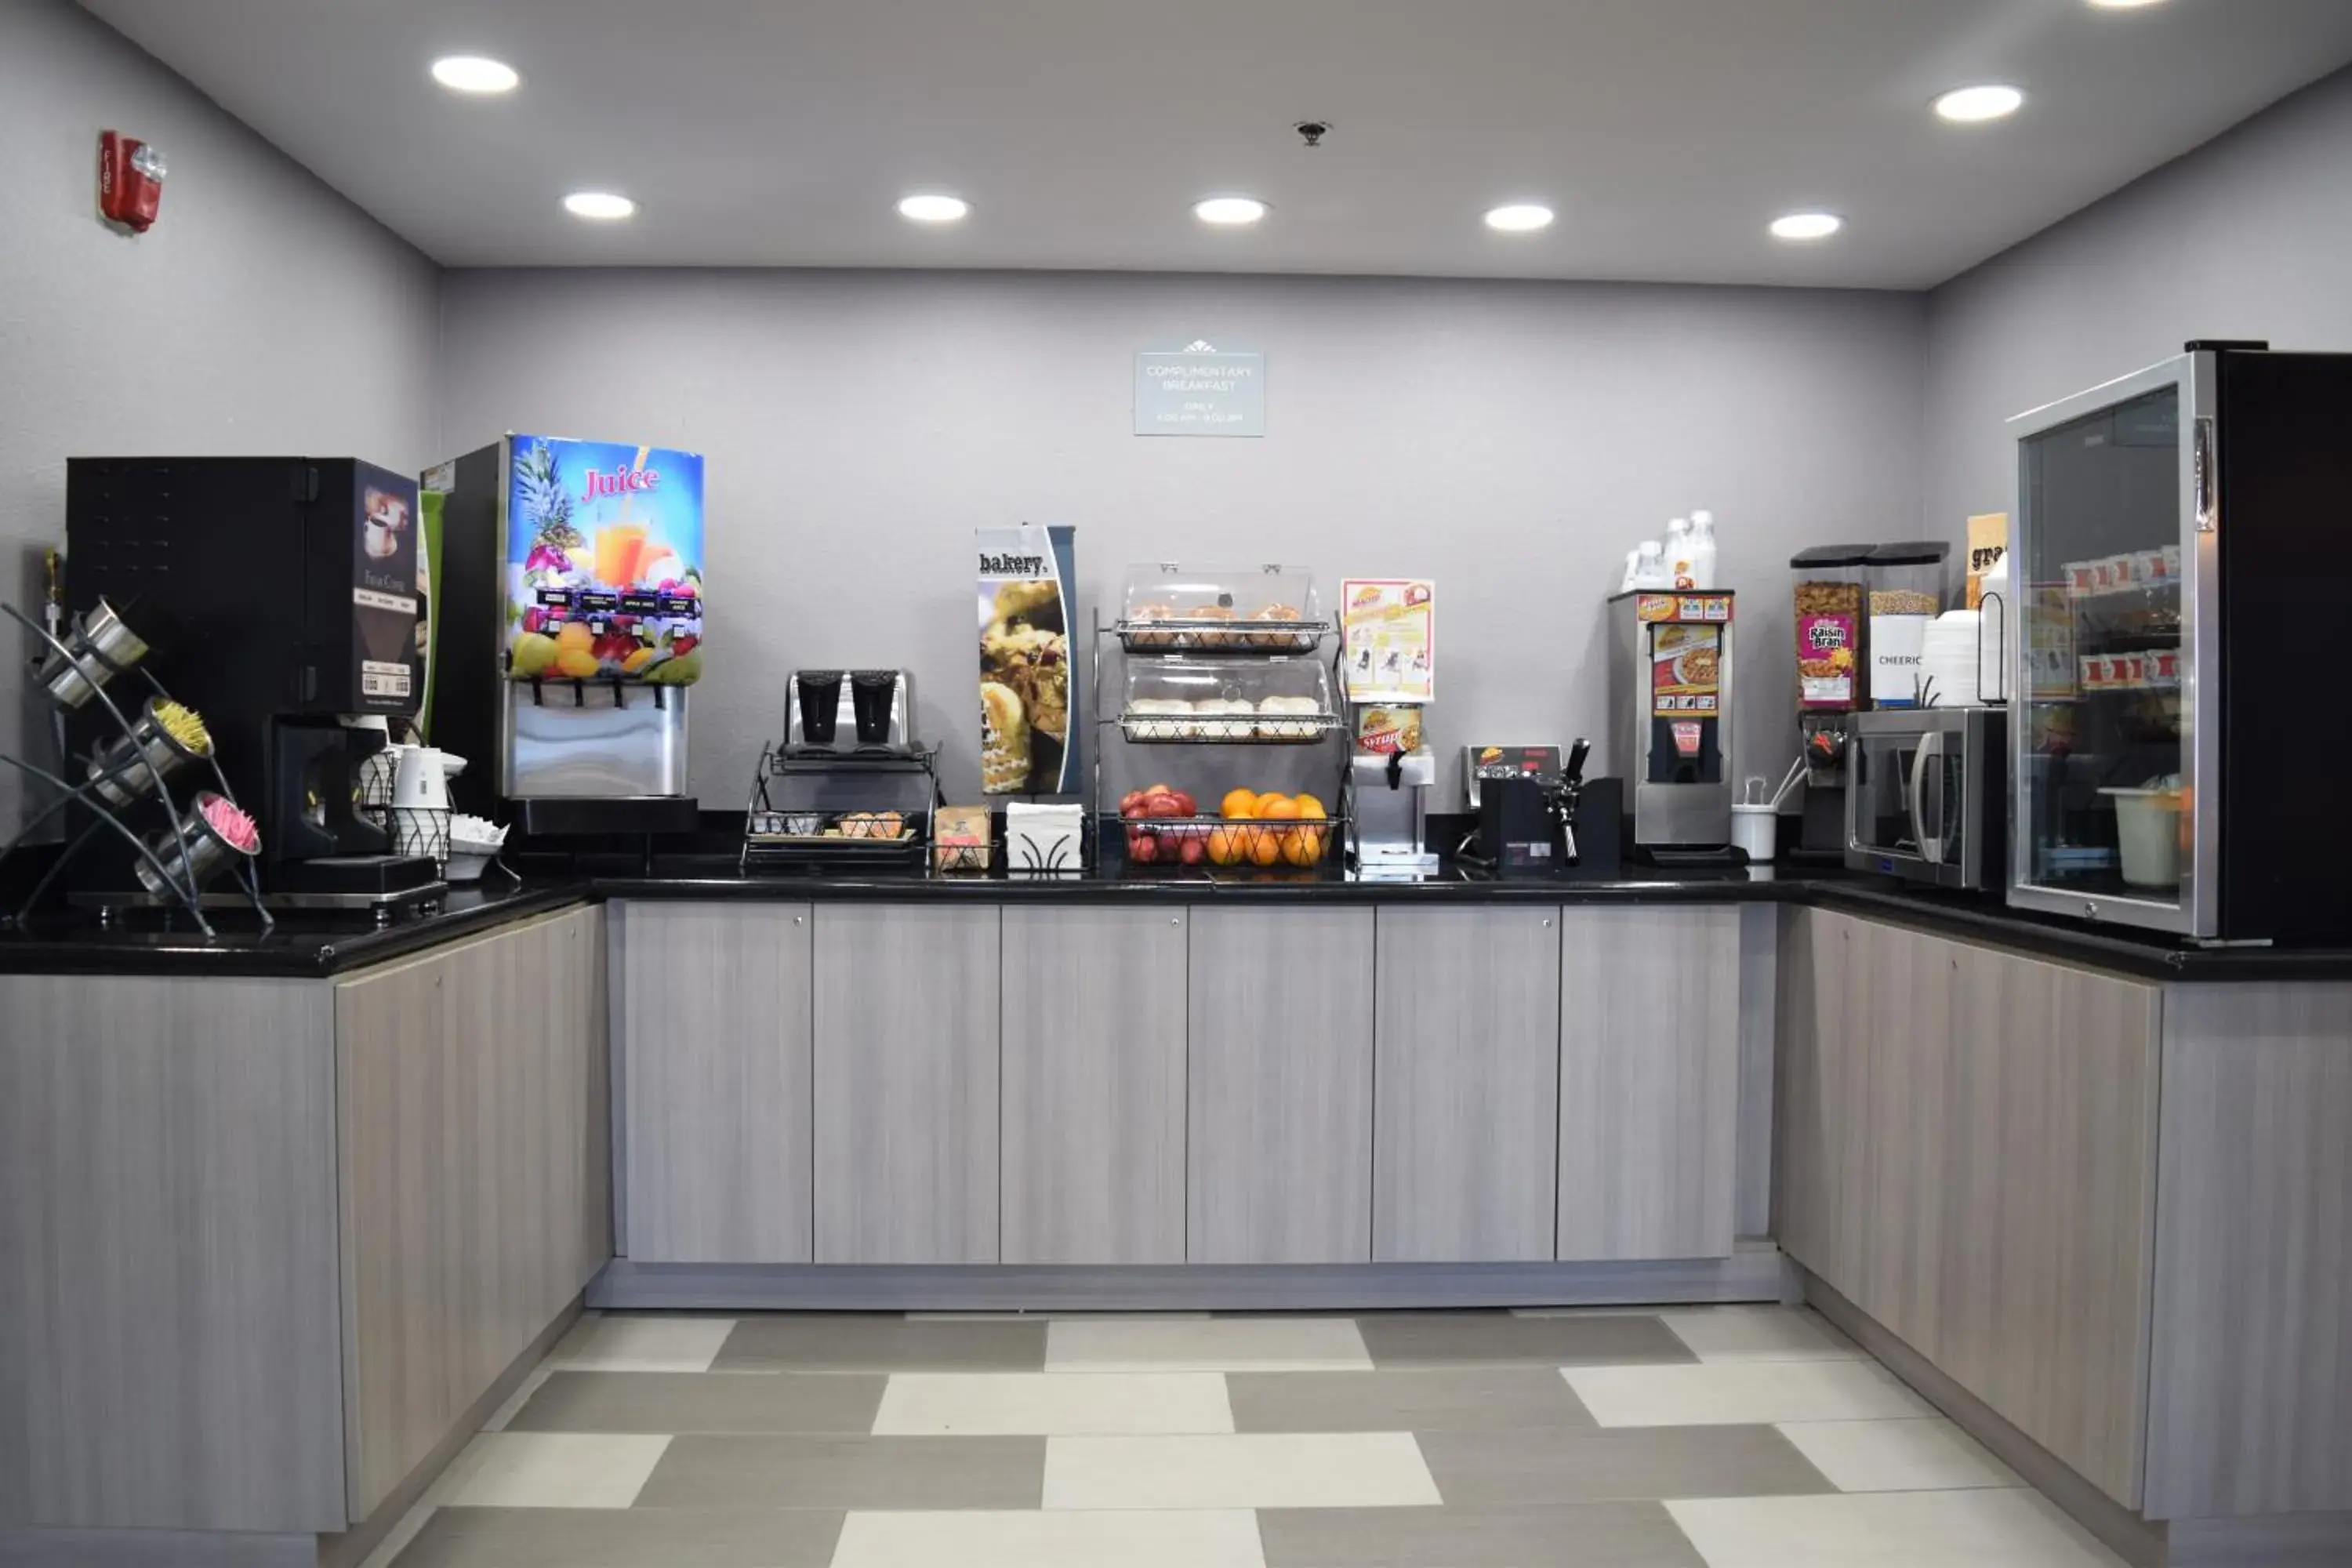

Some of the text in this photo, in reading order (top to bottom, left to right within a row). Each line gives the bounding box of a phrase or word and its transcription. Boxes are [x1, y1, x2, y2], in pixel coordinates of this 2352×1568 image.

[1146, 365, 1252, 377] COMPLIMENTARY
[1163, 379, 1236, 391] BREAKFAST
[581, 466, 660, 502] Juice
[1972, 546, 2008, 572] gra
[978, 554, 1048, 577] bakery.
[1810, 627, 1844, 638] Raisin
[1814, 637, 1840, 647] Bran
